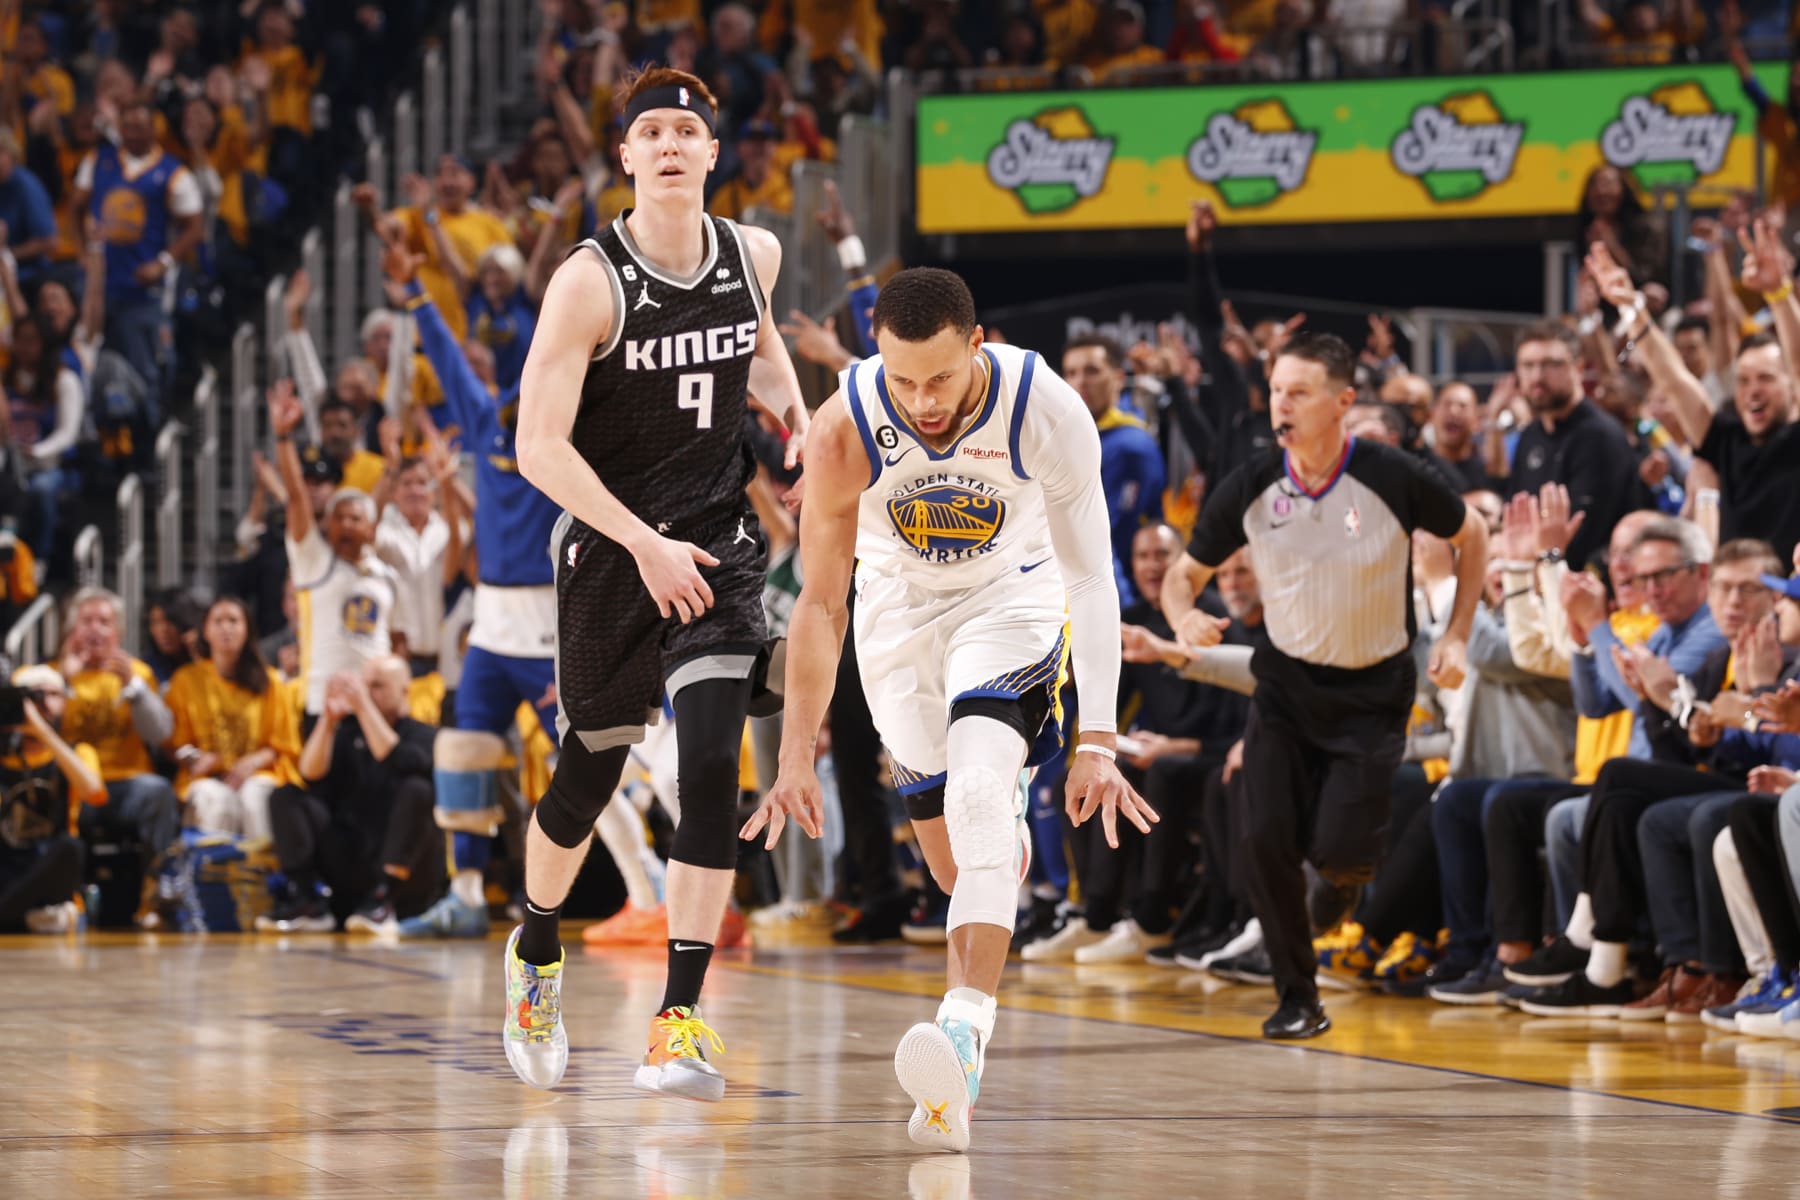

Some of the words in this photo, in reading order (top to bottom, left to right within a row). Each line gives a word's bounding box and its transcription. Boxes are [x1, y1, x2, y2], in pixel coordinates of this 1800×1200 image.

[622, 264, 638, 282] 6
[711, 278, 743, 295] dialpad
[625, 320, 757, 371] KINGS
[678, 373, 714, 429] 9
[881, 427, 897, 448] 6
[963, 447, 1008, 459] Rakuten
[892, 473, 948, 497] OLDEN
[951, 495, 990, 509] 30
